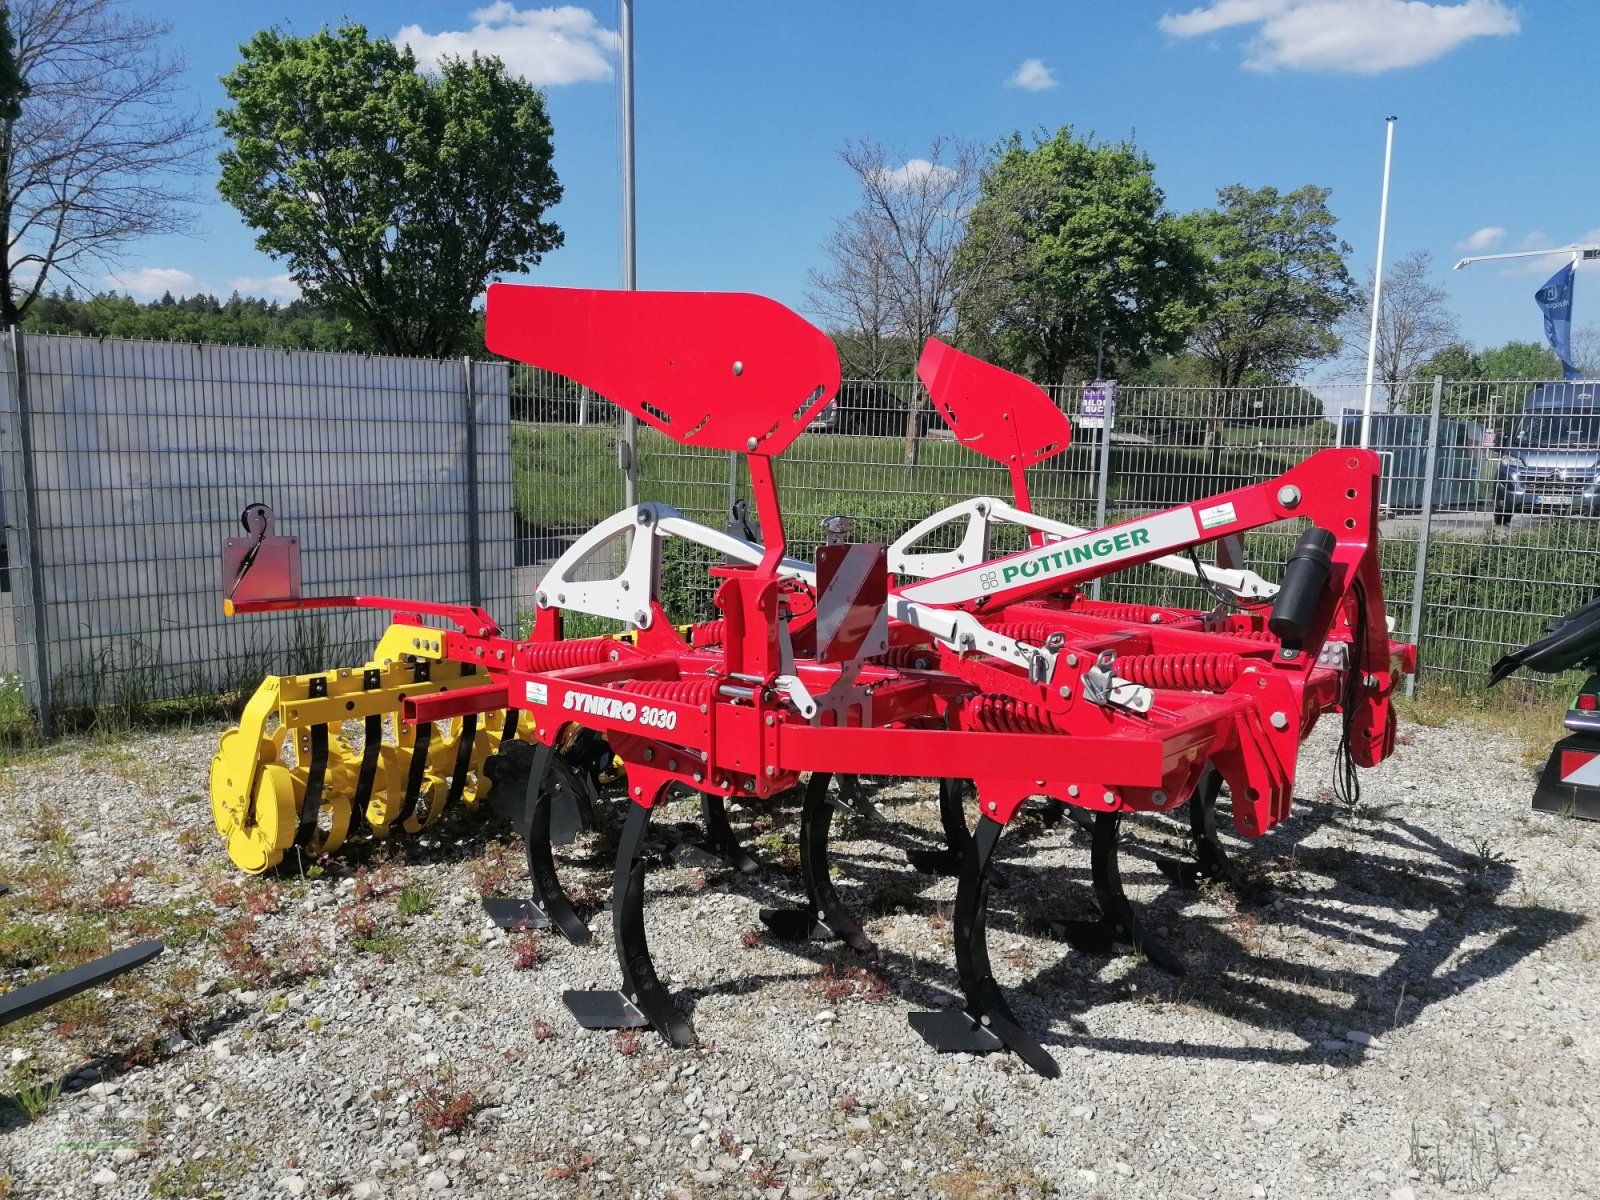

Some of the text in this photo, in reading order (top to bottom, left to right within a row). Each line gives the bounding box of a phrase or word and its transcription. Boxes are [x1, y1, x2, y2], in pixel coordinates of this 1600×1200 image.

[1002, 527, 1151, 583] PÖTTINGER
[563, 690, 637, 722] SYNKRO
[639, 705, 677, 730] 3030
